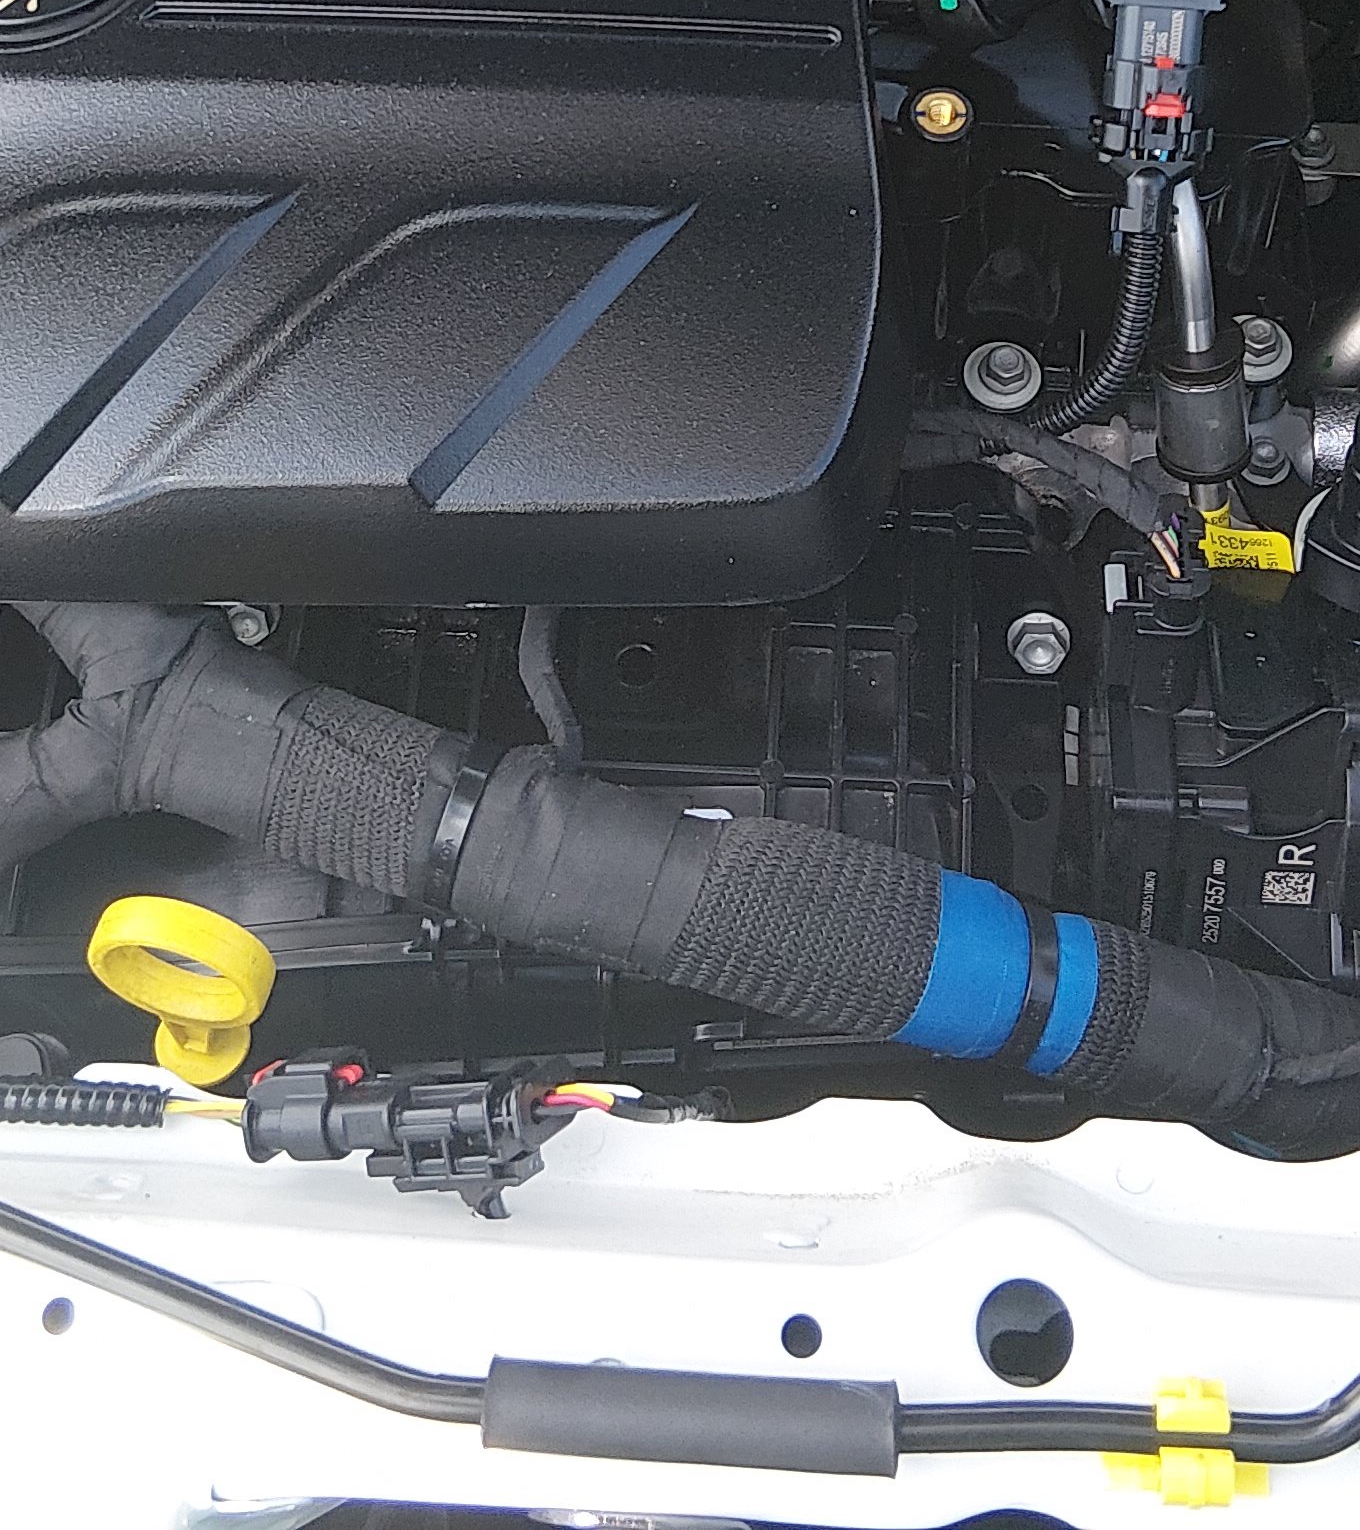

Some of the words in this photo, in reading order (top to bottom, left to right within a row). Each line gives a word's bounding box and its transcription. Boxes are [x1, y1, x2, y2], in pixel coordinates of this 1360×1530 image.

[1277, 844, 1317, 866] R
[1203, 875, 1228, 912] 7557
[1202, 911, 1221, 944] 2520
